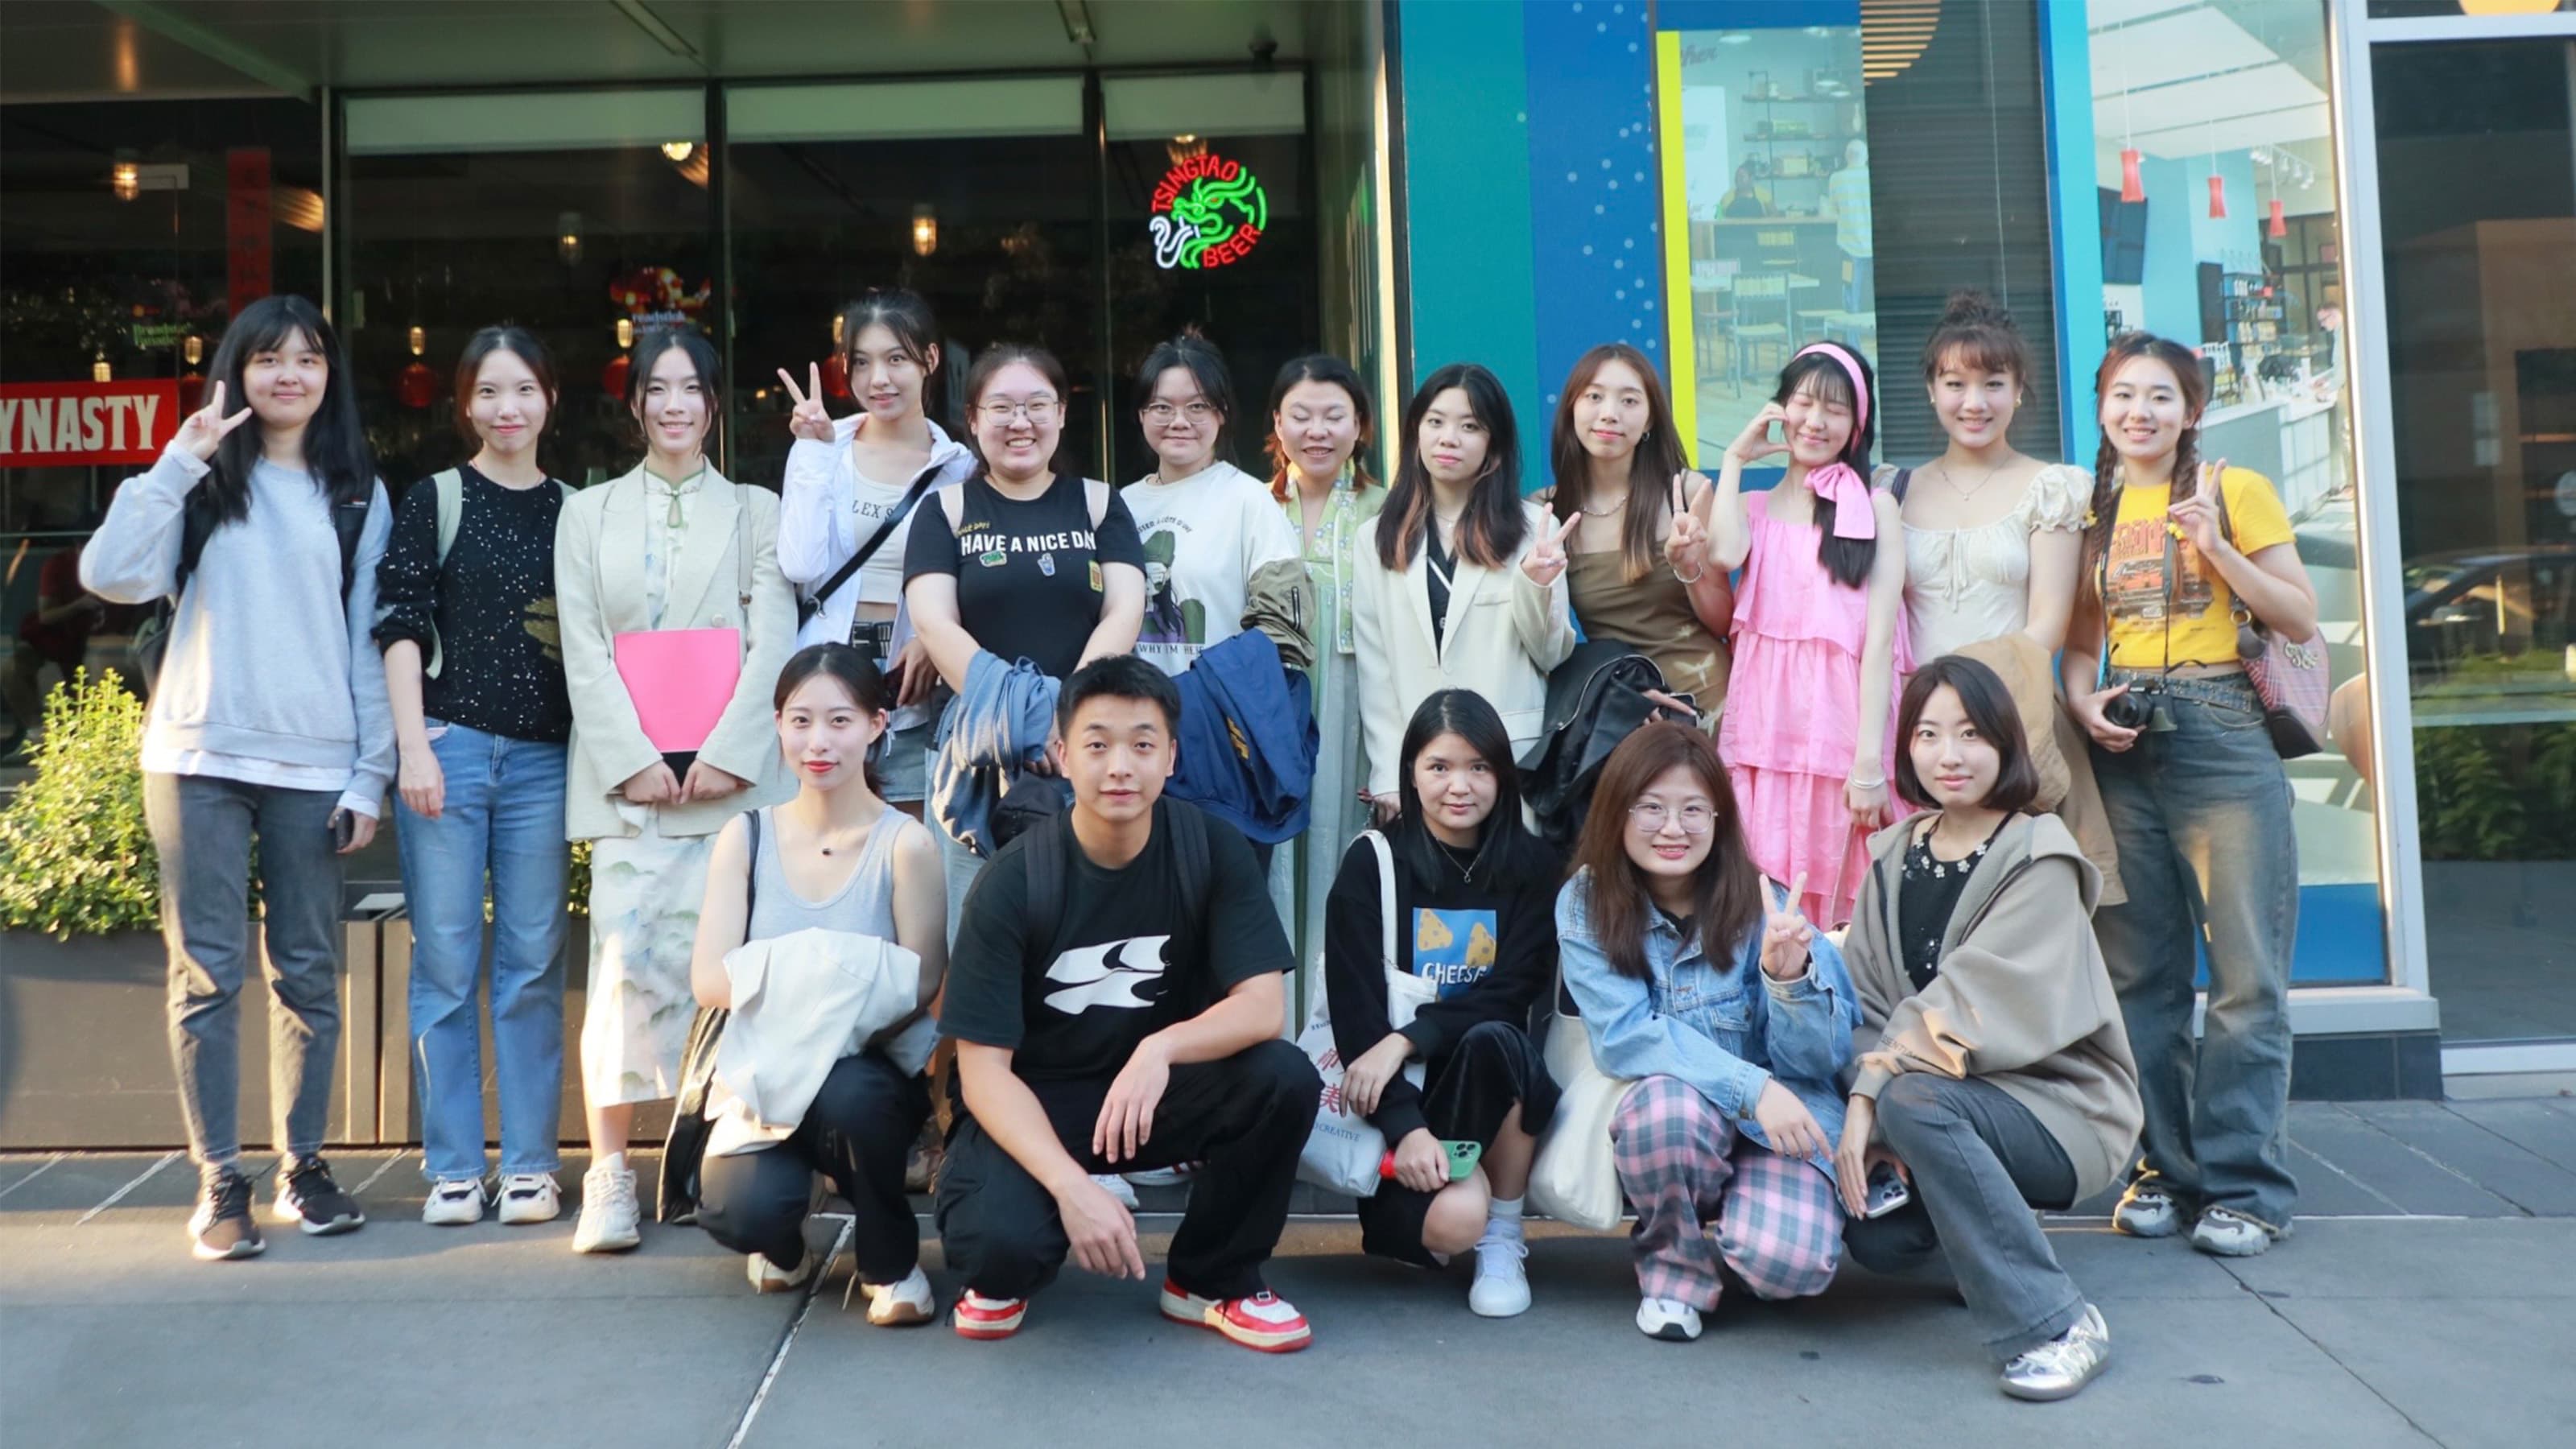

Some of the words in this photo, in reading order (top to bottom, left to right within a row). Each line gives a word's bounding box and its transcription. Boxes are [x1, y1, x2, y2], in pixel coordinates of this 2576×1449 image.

[1151, 154, 1240, 213] TSINGTAO
[1202, 223, 1262, 268] BEER
[961, 534, 1007, 556] HAVE
[1010, 536, 1023, 552] A
[1026, 532, 1070, 552] NICE
[1138, 644, 1161, 654] WHY
[1319, 1122, 1360, 1142] CREATIVE
